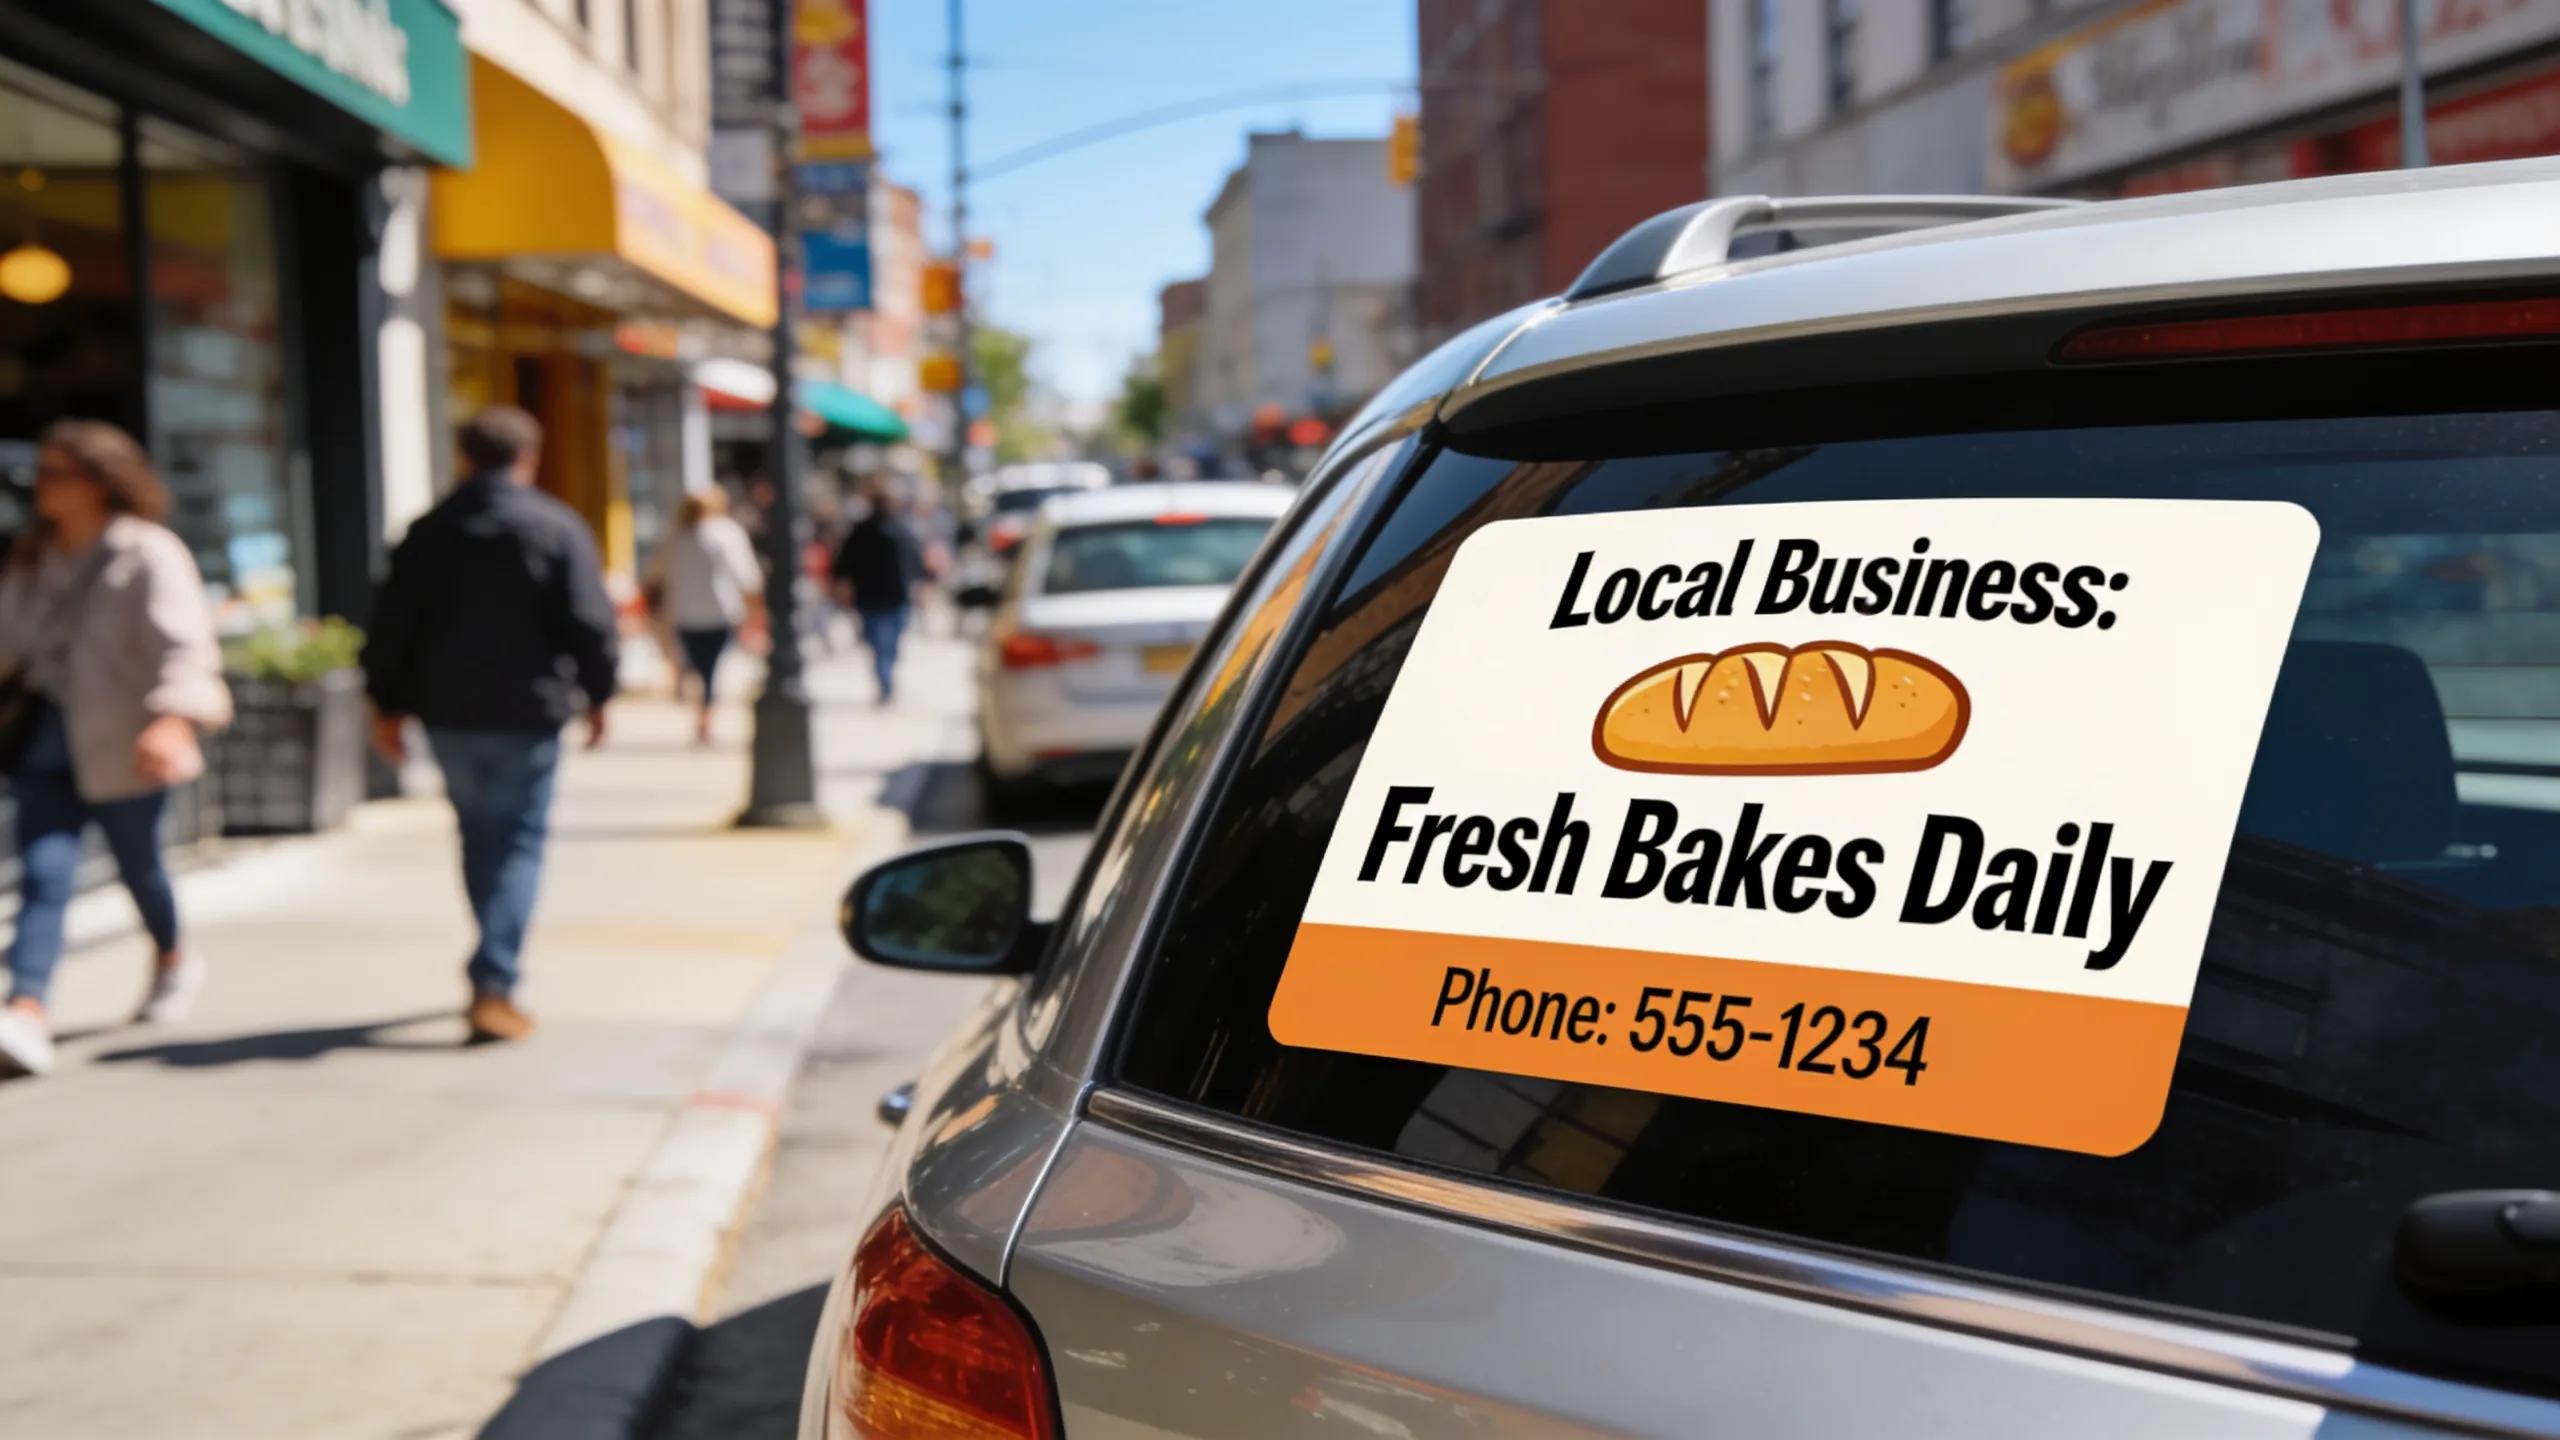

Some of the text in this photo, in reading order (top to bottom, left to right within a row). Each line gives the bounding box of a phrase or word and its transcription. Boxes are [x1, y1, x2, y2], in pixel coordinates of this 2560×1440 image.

[1548, 536, 2130, 632] Local Business:
[1356, 784, 2175, 972] Fresh Bakes Daily
[1430, 965, 1931, 1087] Phone: 555-1234
